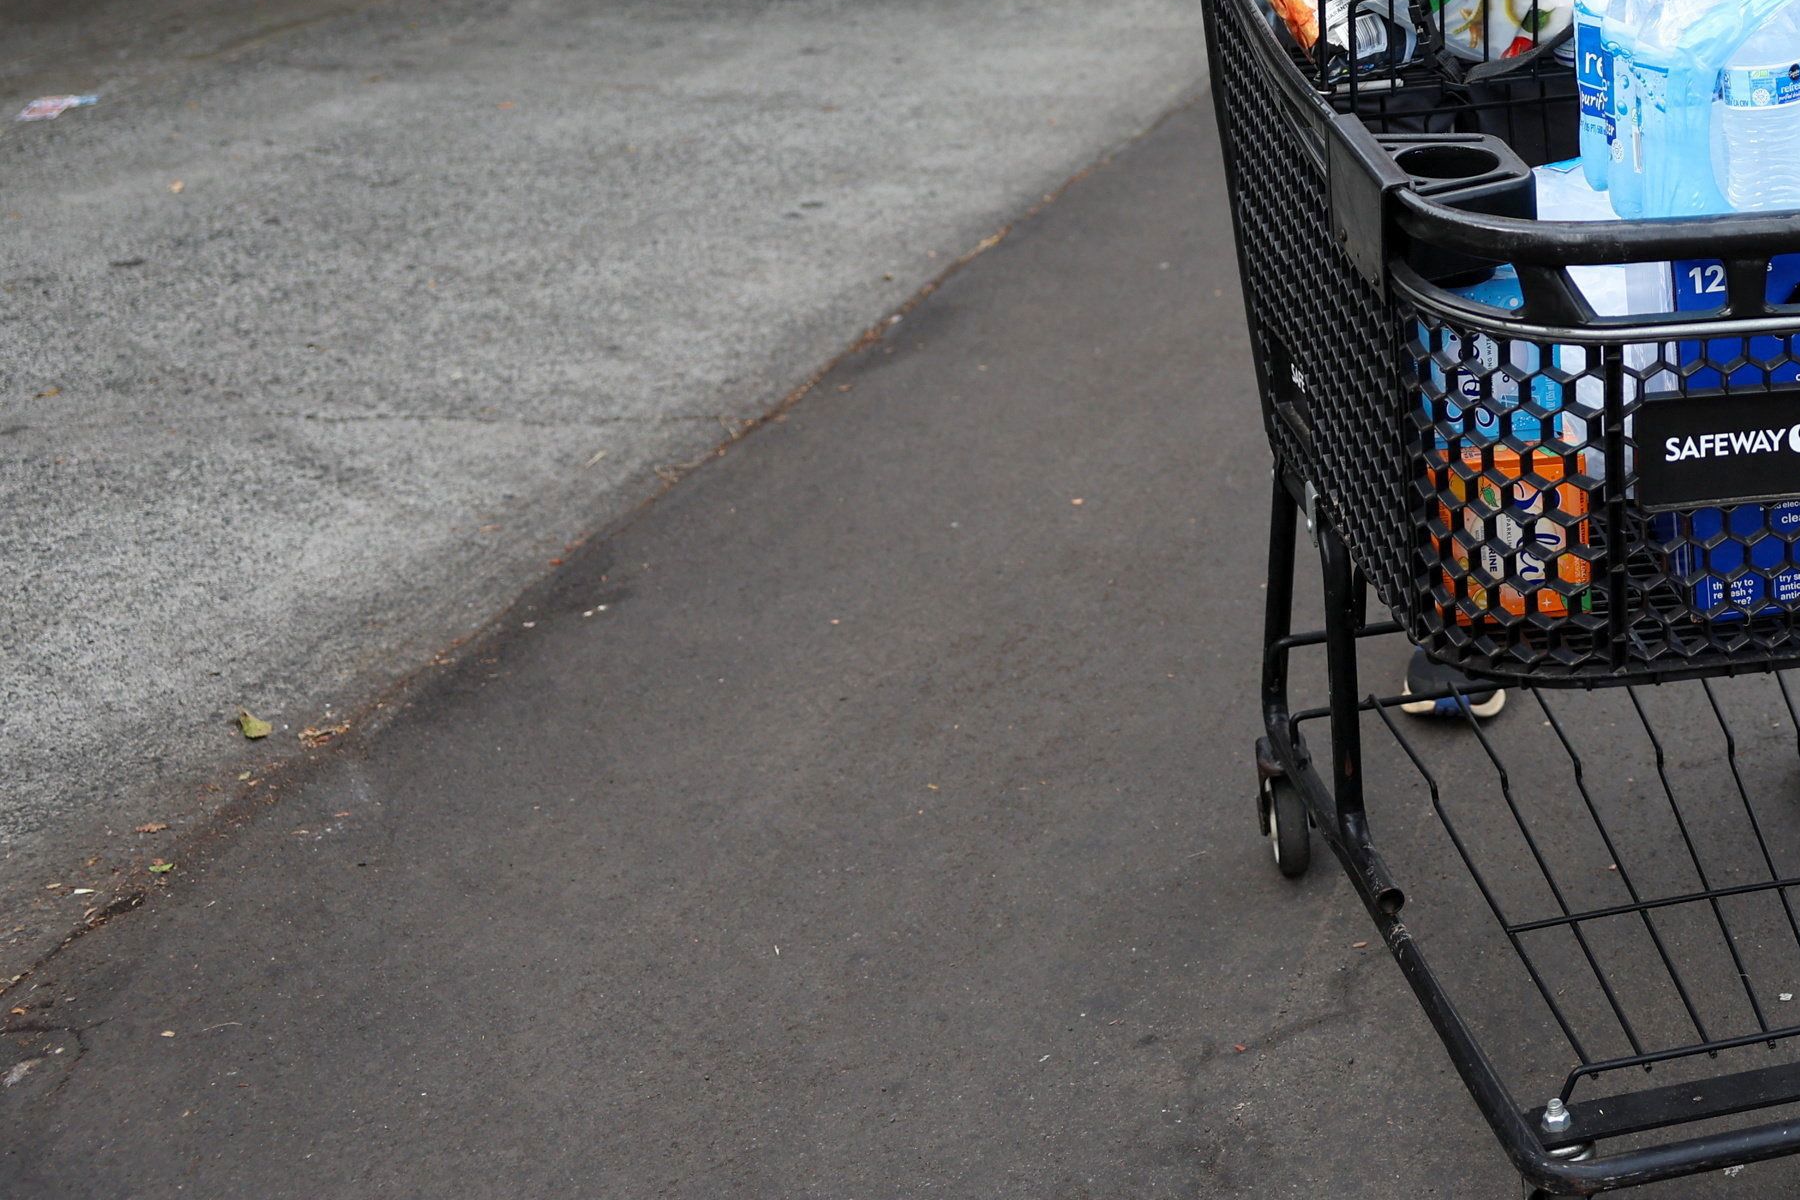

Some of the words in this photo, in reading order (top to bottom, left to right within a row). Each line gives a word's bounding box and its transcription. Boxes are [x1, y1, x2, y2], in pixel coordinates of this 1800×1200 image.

[1688, 264, 1726, 294] 12
[1665, 428, 1787, 462] SAFEWAY
[1743, 579, 1754, 587] to
[1779, 574, 1792, 583] try
